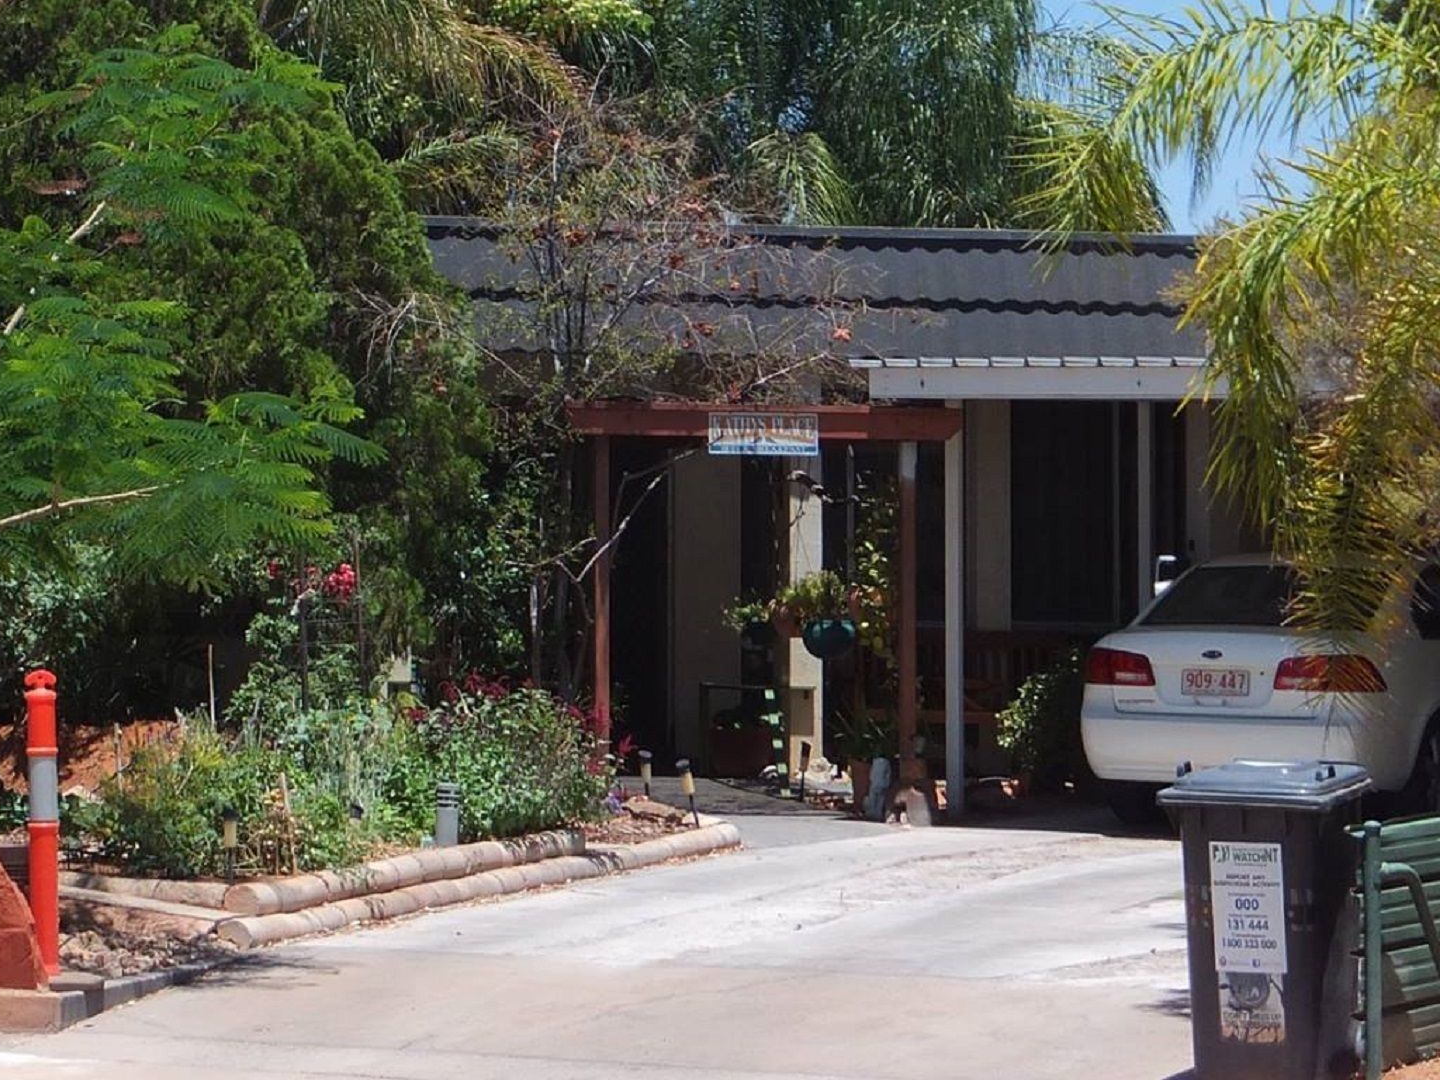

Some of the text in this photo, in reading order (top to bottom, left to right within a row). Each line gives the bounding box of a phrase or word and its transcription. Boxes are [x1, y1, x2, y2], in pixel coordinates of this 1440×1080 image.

[1235, 898, 1259, 911] 000
[1228, 919, 1269, 931] 131 444
